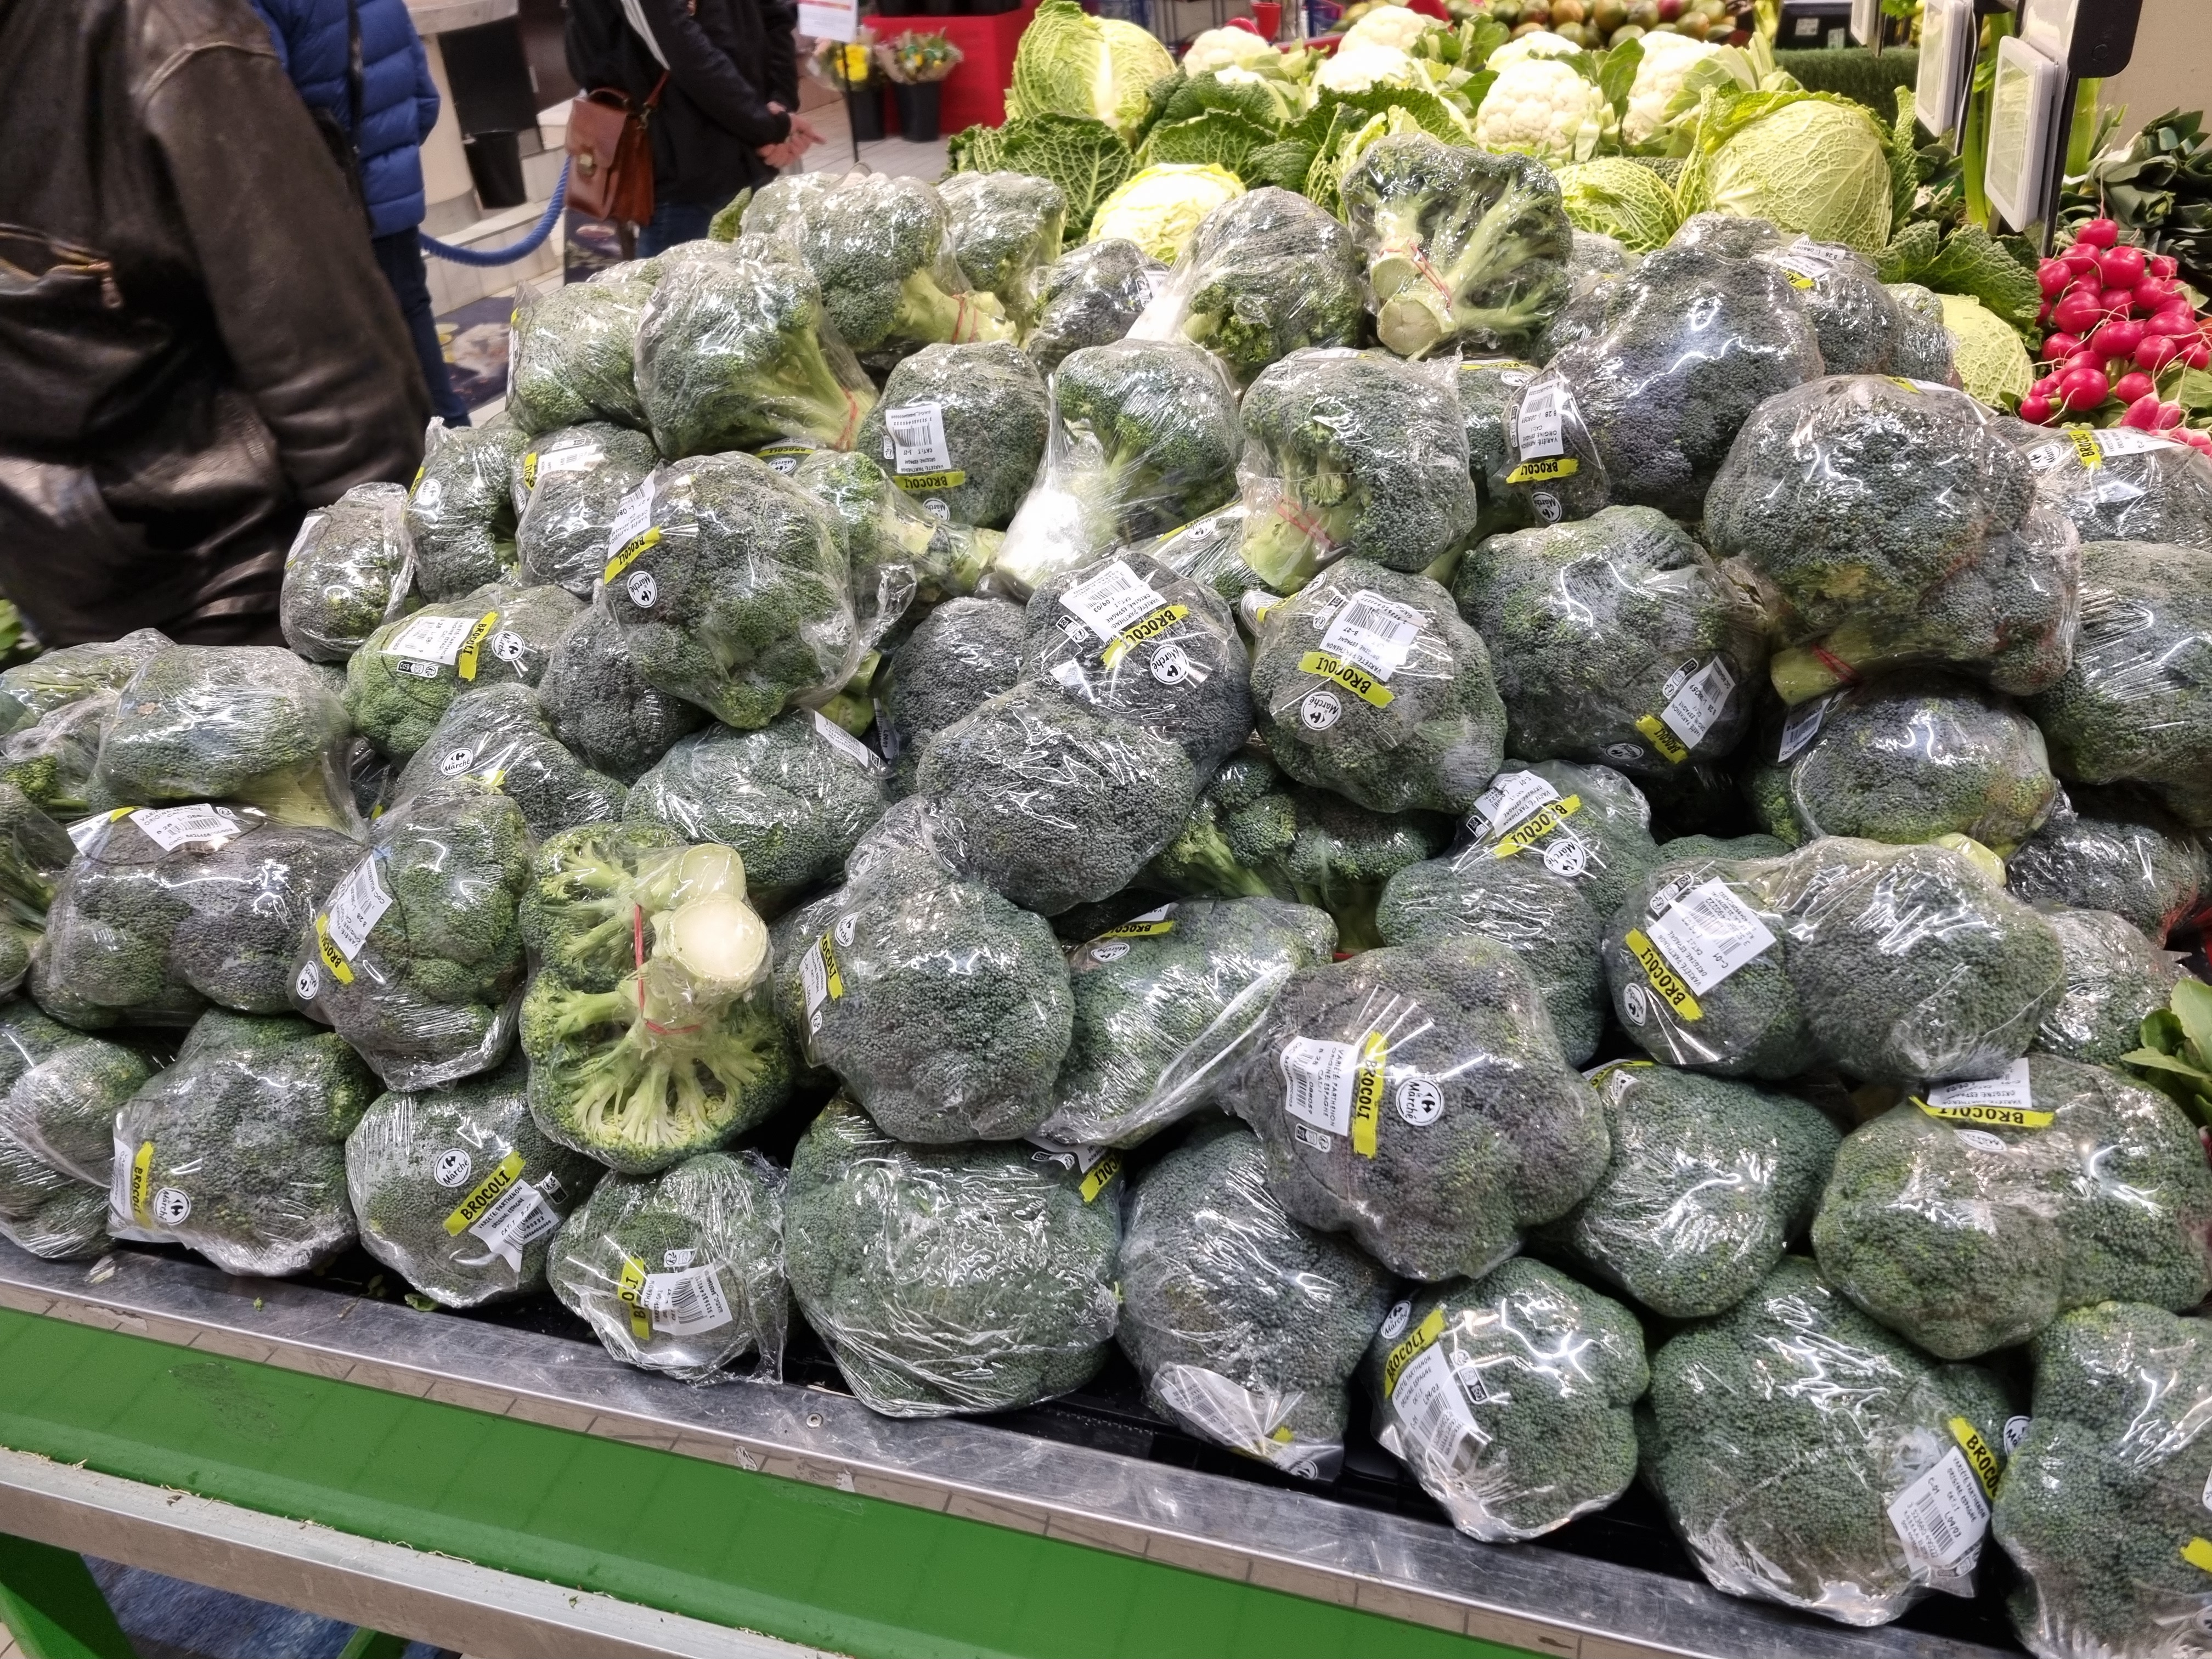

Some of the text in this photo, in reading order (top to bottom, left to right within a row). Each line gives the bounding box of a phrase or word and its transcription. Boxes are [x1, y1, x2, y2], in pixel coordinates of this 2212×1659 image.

[1520, 461, 1558, 476] BROCOLI
[904, 476, 947, 489] BROCOLI
[615, 535, 647, 566] BROCOLI
[629, 573, 651, 595] Marché
[1105, 607, 1128, 624] ESPAGNE
[1119, 608, 1177, 650] BROCOLI
[462, 620, 488, 656] BROCOLI
[497, 631, 512, 657] Marché
[1152, 647, 1181, 672] Marché
[1314, 654, 1373, 695] BROCOLI
[1308, 696, 1339, 715] Marché
[1653, 726, 1680, 754] BROCOLI
[442, 756, 470, 771] Marché
[1502, 799, 1523, 817] ESPAGNE
[1510, 802, 1568, 848] BROCOLI
[1546, 842, 1577, 868] Marché
[1656, 933, 1683, 964] PARTHENON
[1667, 929, 1688, 953] ESPAGNE
[1712, 952, 1729, 969] C-01
[1637, 947, 1686, 1006] BROCOLI
[1312, 1056, 1319, 1066] 28
[1324, 1047, 1338, 1080] ORIGINE:
[1332, 1049, 1345, 1080] VARIÉTÉ:
[1357, 1060, 1378, 1120] BROCOLI
[1405, 1081, 1420, 1119] Marché
[1937, 1106, 2023, 1122] BROCOLI
[442, 1157, 470, 1185] Marché
[460, 1168, 512, 1221] BROCOLI
[495, 1184, 523, 1212] PARTHENON
[1381, 1307, 1409, 1335] Marché
[1380, 1325, 1429, 1382] BROCOLI
[1404, 1354, 1432, 1381] PARTHENON
[1412, 1365, 1433, 1387] ESPAGNE
[1960, 1496, 1977, 1522] ESPAGNE
[1966, 1482, 1987, 1518] PARTHENON
[1942, 1511, 1962, 1538] L09/03
